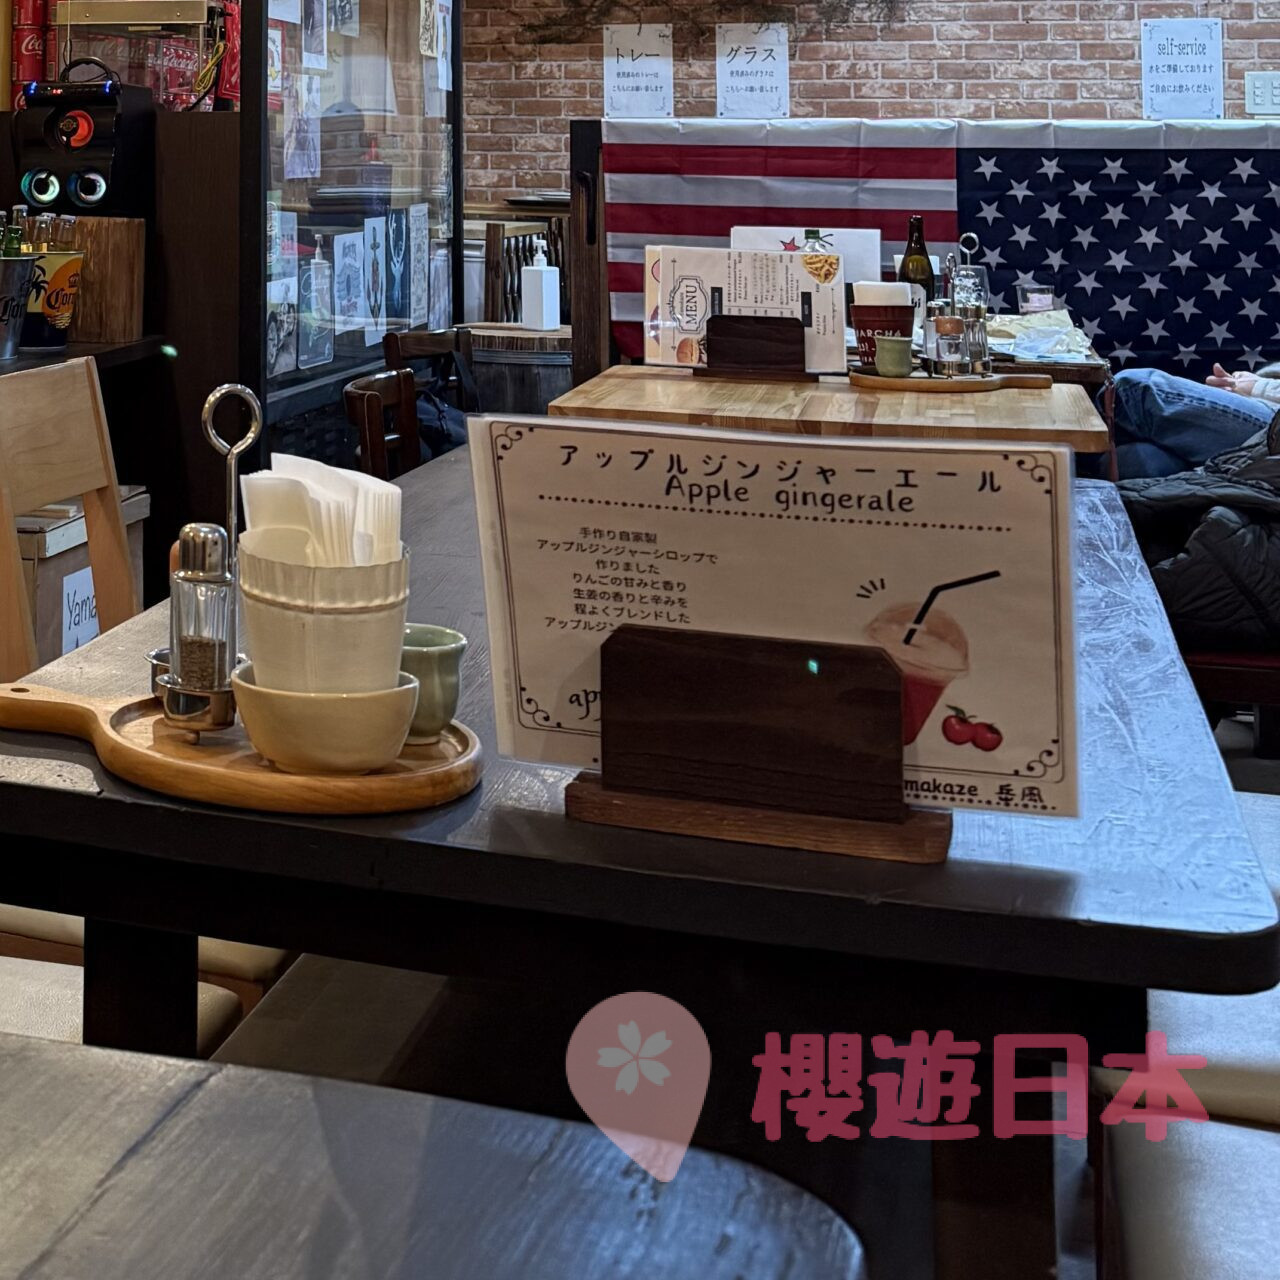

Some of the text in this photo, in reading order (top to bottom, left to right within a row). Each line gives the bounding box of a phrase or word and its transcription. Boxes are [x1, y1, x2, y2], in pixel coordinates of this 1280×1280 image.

[616, 47, 660, 64] トレー
[726, 45, 777, 64] グラス
[1157, 37, 1207, 56] self-service
[685, 284, 698, 325] MENU
[559, 444, 1002, 494] アップルジンジャーエール
[665, 474, 915, 515] Apple gingerale
[578, 526, 658, 545] 手作り自家製
[536, 538, 719, 565] アップルジンジャーシロップで
[595, 558, 661, 576] 作りました
[572, 572, 687, 593] りんごの甘みと香り
[573, 587, 688, 609] 生姜の香りと辛みを
[574, 602, 691, 625] 程よくブレンドした
[995, 783, 1044, 805] 岳風
